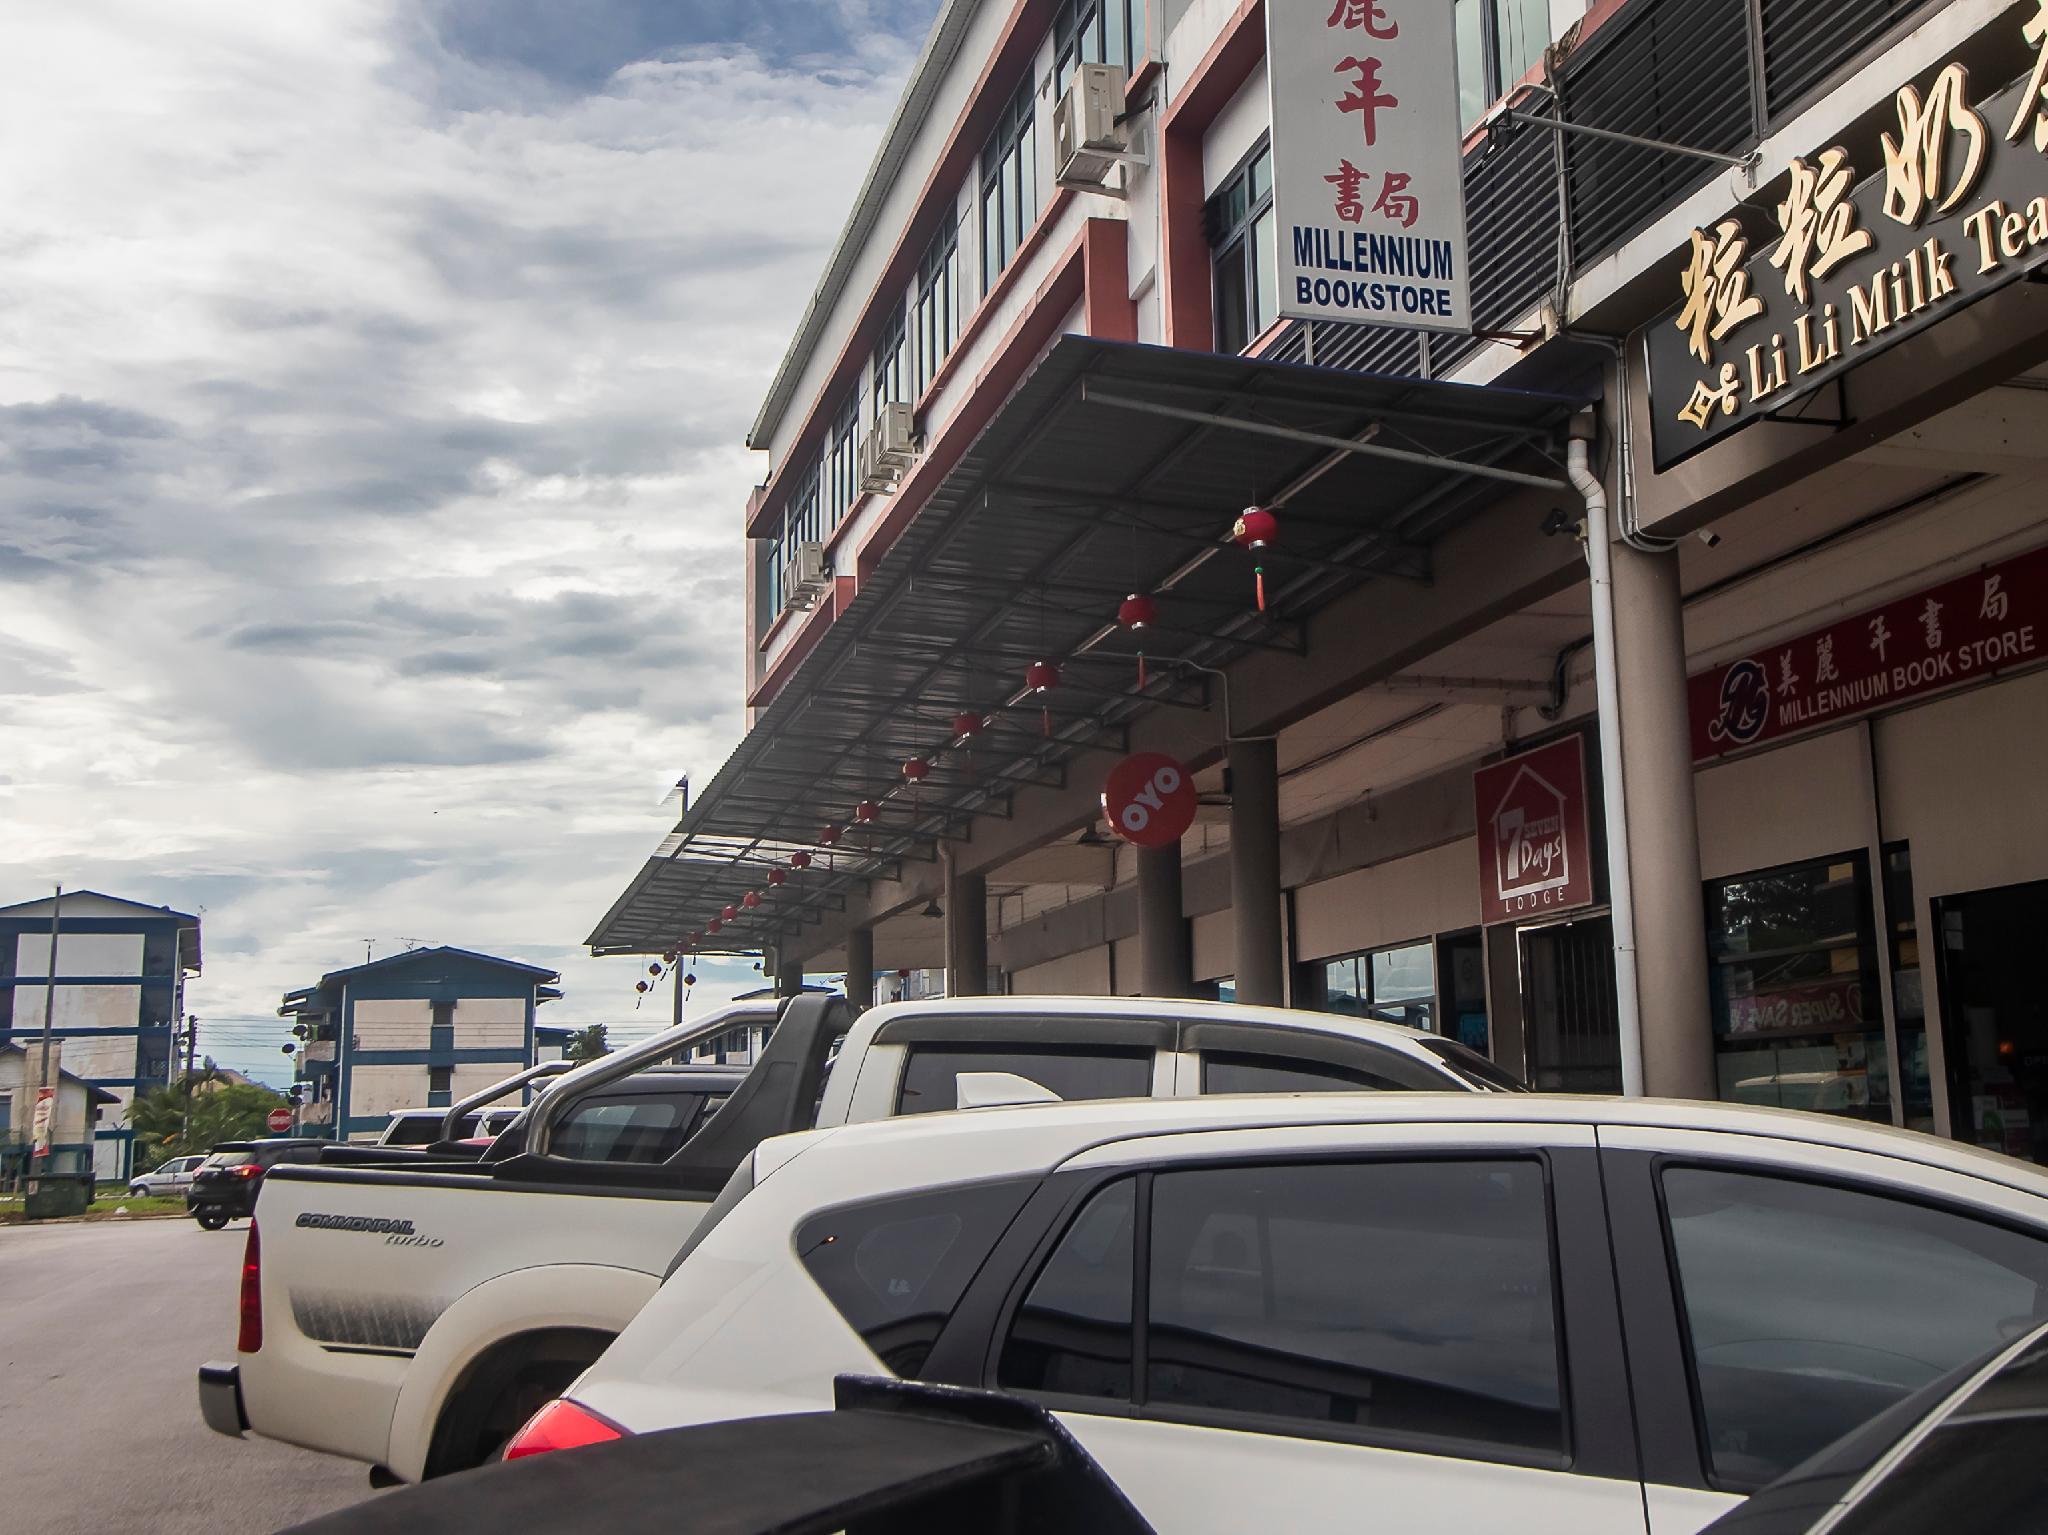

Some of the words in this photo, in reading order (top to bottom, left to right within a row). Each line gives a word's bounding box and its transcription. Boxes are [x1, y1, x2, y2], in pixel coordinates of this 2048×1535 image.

[1293, 226, 1453, 281] MILLENNIUM
[1296, 276, 1453, 316] BOOKSTORE
[1746, 333, 1789, 403] Li
[1794, 303, 1843, 375] Li
[1847, 237, 1958, 346] Milk
[1963, 196, 2048, 275] Tea
[1779, 675, 1889, 726] MILLENNIUM
[1893, 651, 1953, 692] BOOK
[1958, 625, 2036, 671] STORE
[1122, 767, 1180, 831] OYO
[1500, 807, 1525, 880] 7
[1521, 836, 1562, 877] Days
[1505, 887, 1565, 913] LODGE
[296, 1212, 416, 1235] COMMONRAIL
[386, 1234, 445, 1248] turbo
